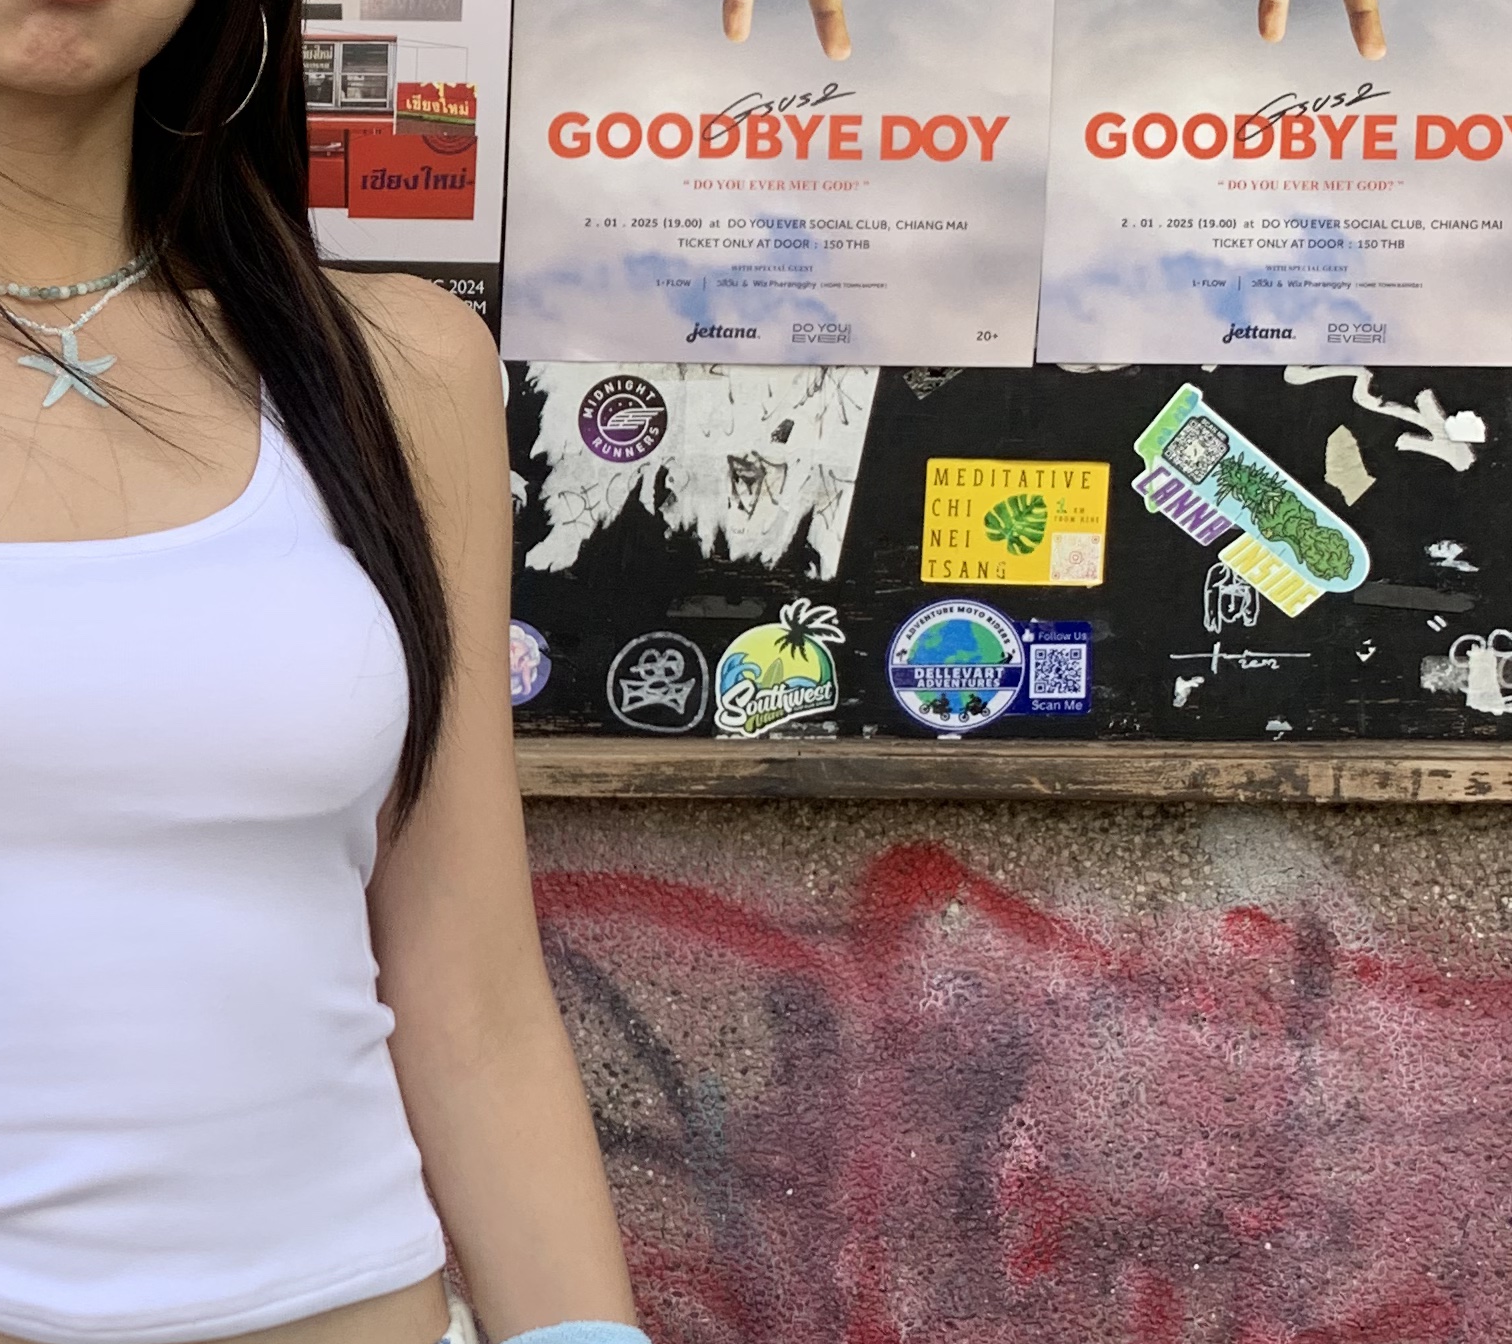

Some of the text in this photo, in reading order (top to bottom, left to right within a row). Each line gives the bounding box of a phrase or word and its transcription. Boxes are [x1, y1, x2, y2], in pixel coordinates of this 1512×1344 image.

[547, 110, 1011, 163] GOODBYE DOY
[1084, 111, 1512, 162] GOODBYE DO
[449, 279, 485, 295] 2024
[582, 379, 656, 419] MIDNIGHT
[591, 426, 660, 459] RUNNERS
[933, 467, 1092, 490] MEDITATIVE
[931, 497, 972, 518] CHI
[1135, 465, 1234, 546] CANNA
[929, 528, 971, 549] NEI
[927, 559, 1007, 580] TSANG
[1222, 535, 1319, 617] INSIDE
[905, 605, 1011, 645] ADVENTURE MOTO RIDERS
[1037, 631, 1088, 642] Follow Us
[913, 666, 1005, 680] DELLEVART
[916, 678, 1001, 689] ADVENTURES
[718, 678, 833, 728] Southwest
[1031, 699, 1084, 712] Scan Me
